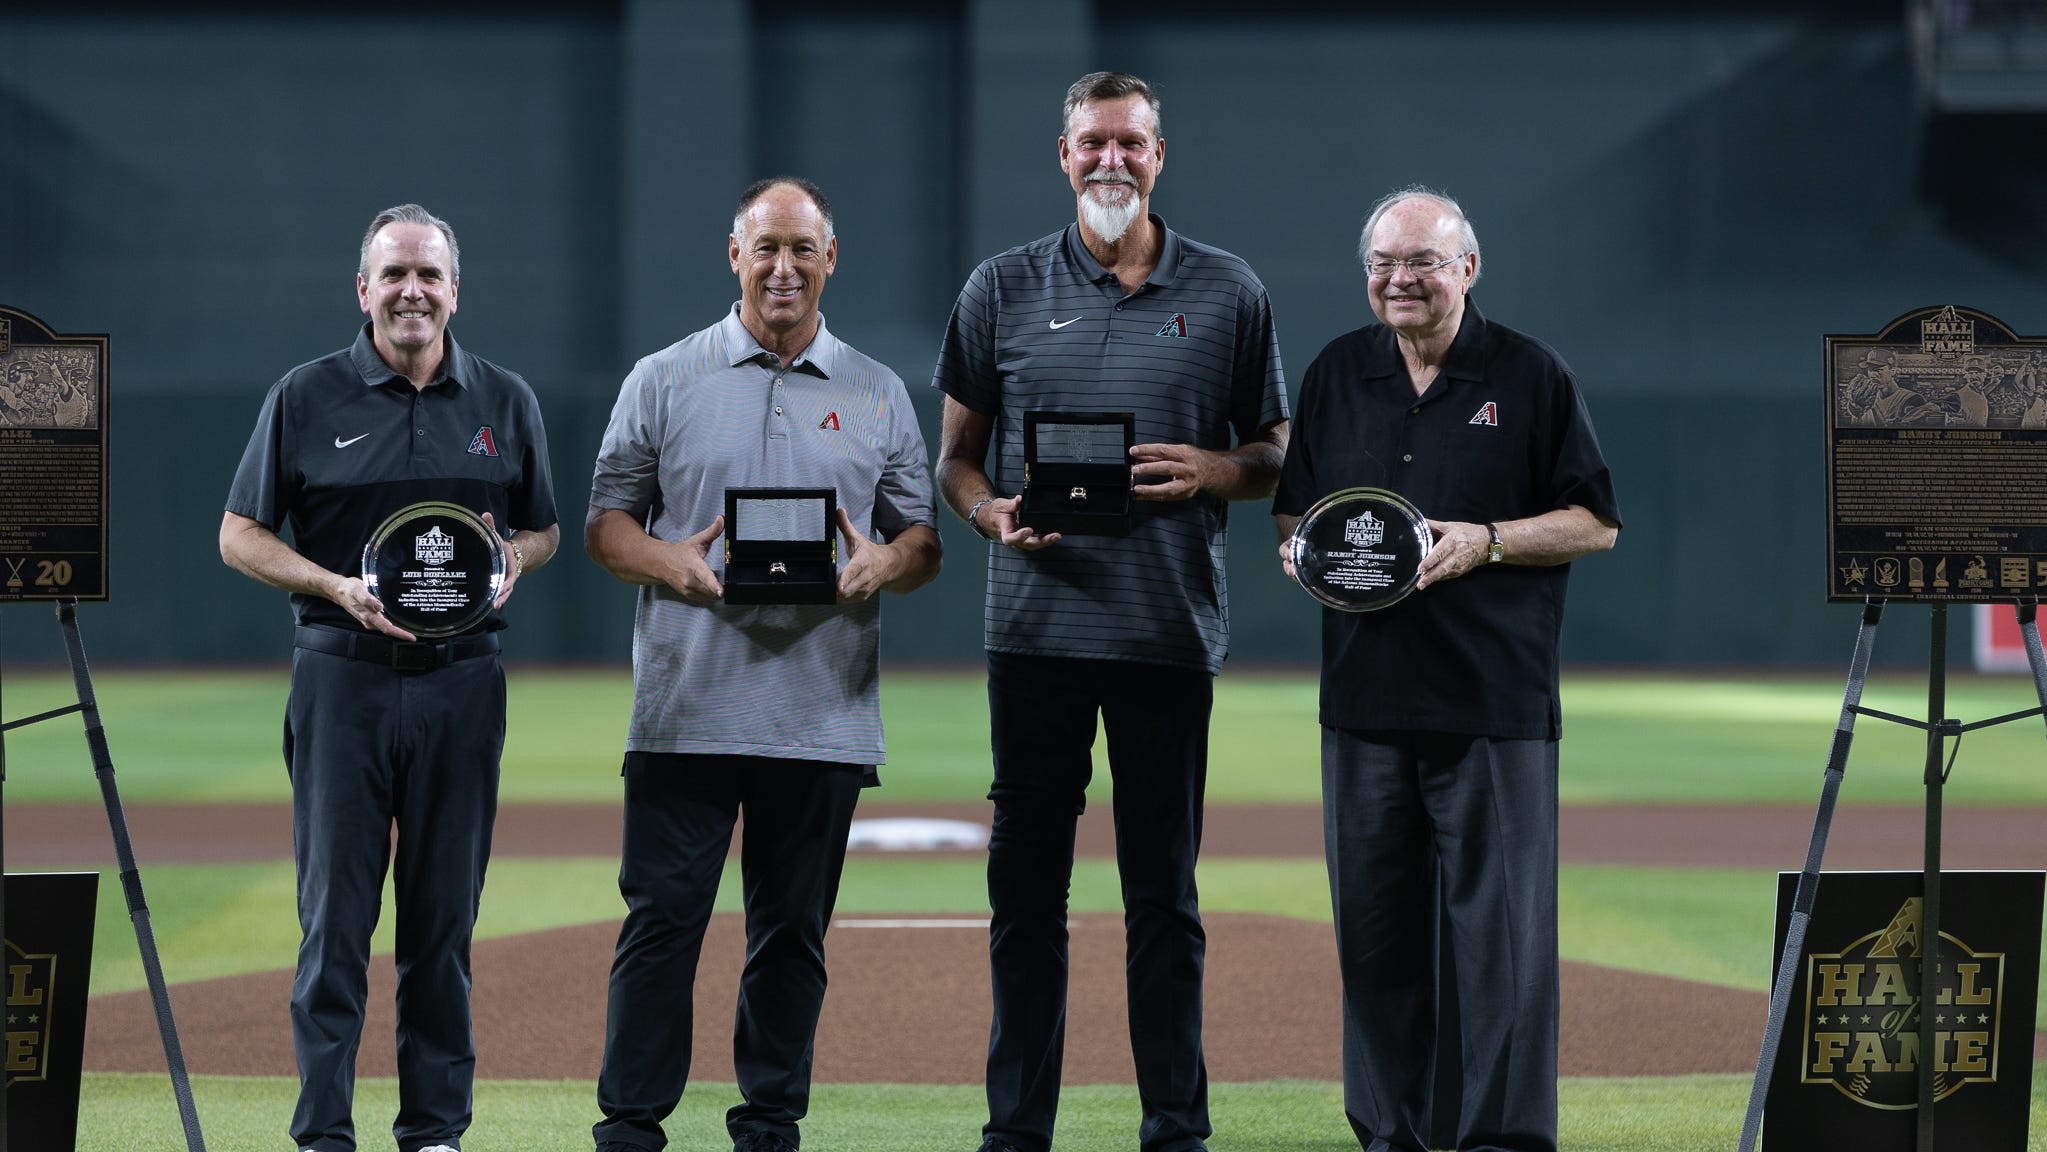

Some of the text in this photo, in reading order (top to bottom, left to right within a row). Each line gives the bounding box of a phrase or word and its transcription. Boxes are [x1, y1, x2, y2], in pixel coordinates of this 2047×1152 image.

[1925, 322, 1971, 334] HALL
[1925, 340, 1971, 352] FAME
[1898, 430, 2002, 440] RANDY JOHNSON
[1349, 522, 1382, 530] HALL
[418, 538, 451, 546] HALL
[1348, 532, 1380, 542] FAME
[418, 550, 451, 558] FAME
[35, 560, 72, 586] 20
[1880, 1000, 1918, 1038] of
